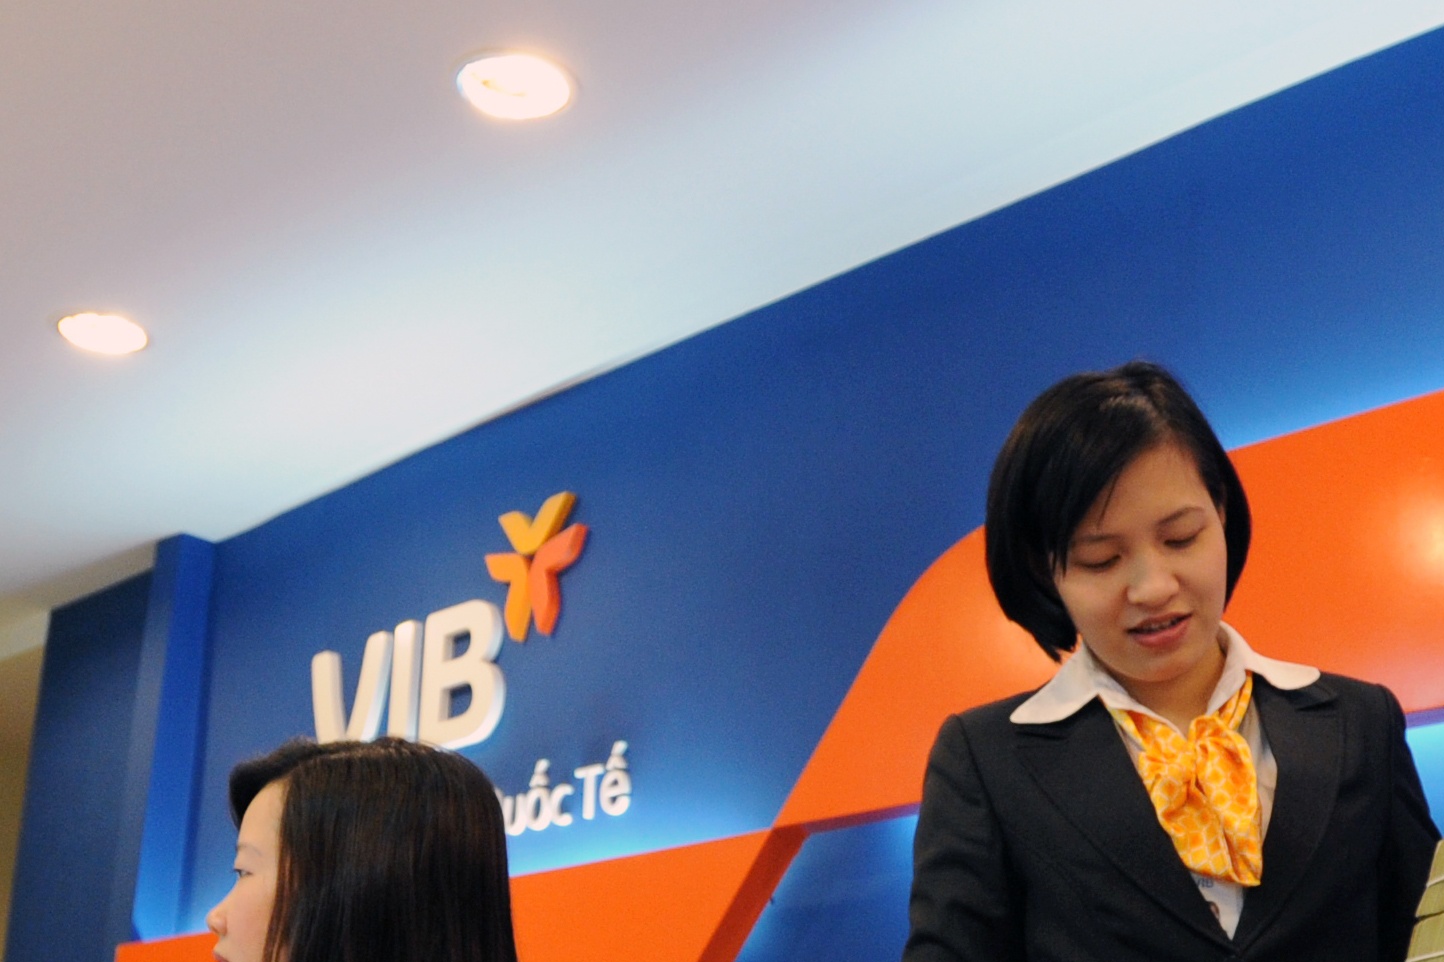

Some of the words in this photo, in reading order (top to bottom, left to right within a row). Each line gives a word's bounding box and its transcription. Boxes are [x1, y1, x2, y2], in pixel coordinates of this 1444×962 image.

[311, 599, 506, 750] VIB
[497, 758, 575, 836] uốc
[574, 739, 632, 820] Tế
